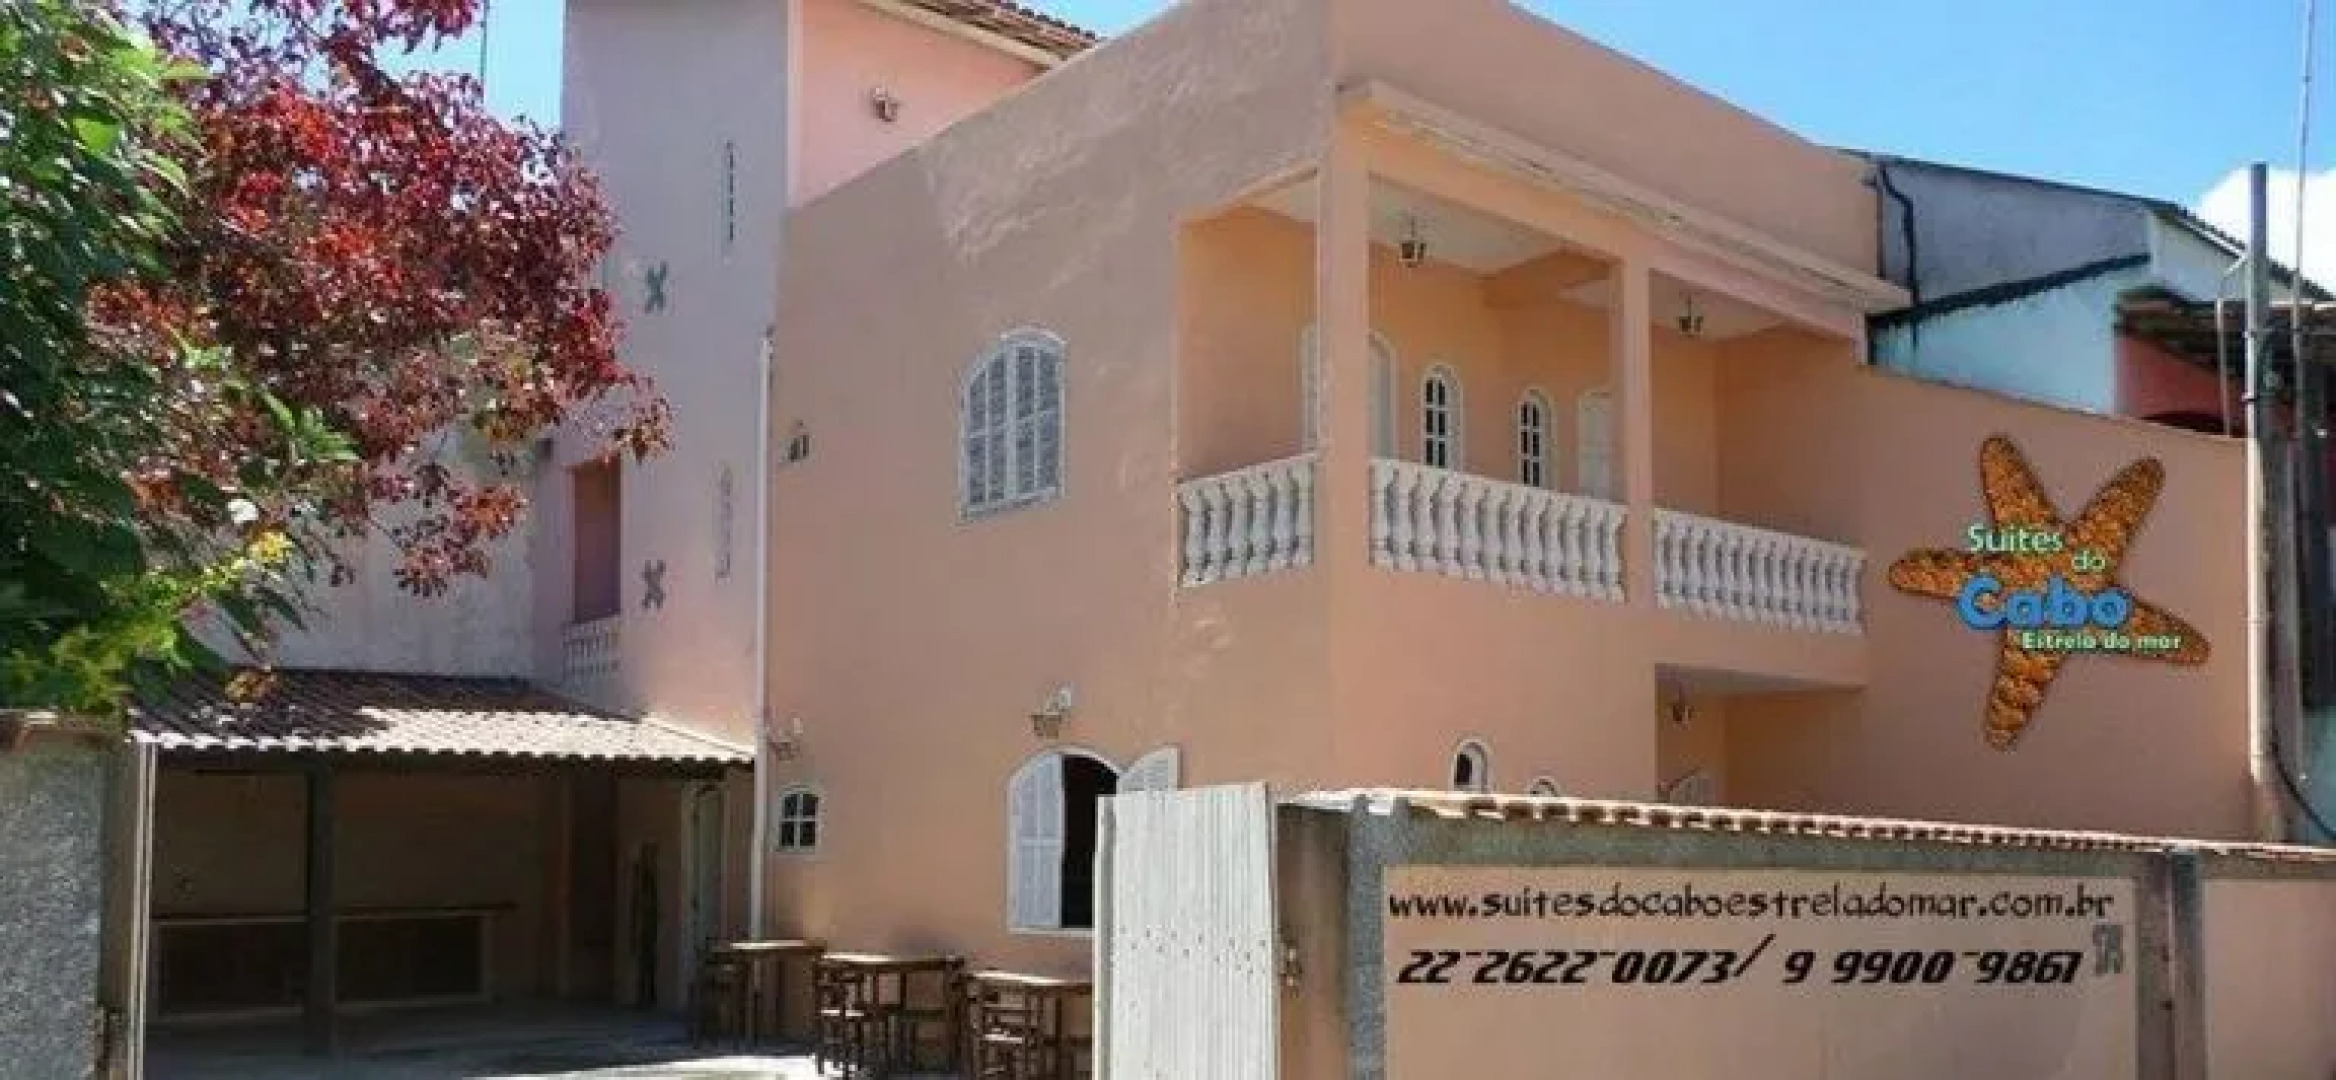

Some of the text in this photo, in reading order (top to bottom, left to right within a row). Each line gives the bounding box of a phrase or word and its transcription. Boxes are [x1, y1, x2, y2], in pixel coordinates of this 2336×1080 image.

[1967, 523, 2064, 552] Suites
[2071, 549, 2106, 572] do
[1957, 572, 2131, 628] Cabo
[2137, 634, 2182, 649] mar
[1389, 882, 2114, 917] www.suitesdocaboestreladomar.com.br
[1782, 951, 1816, 983] 9
